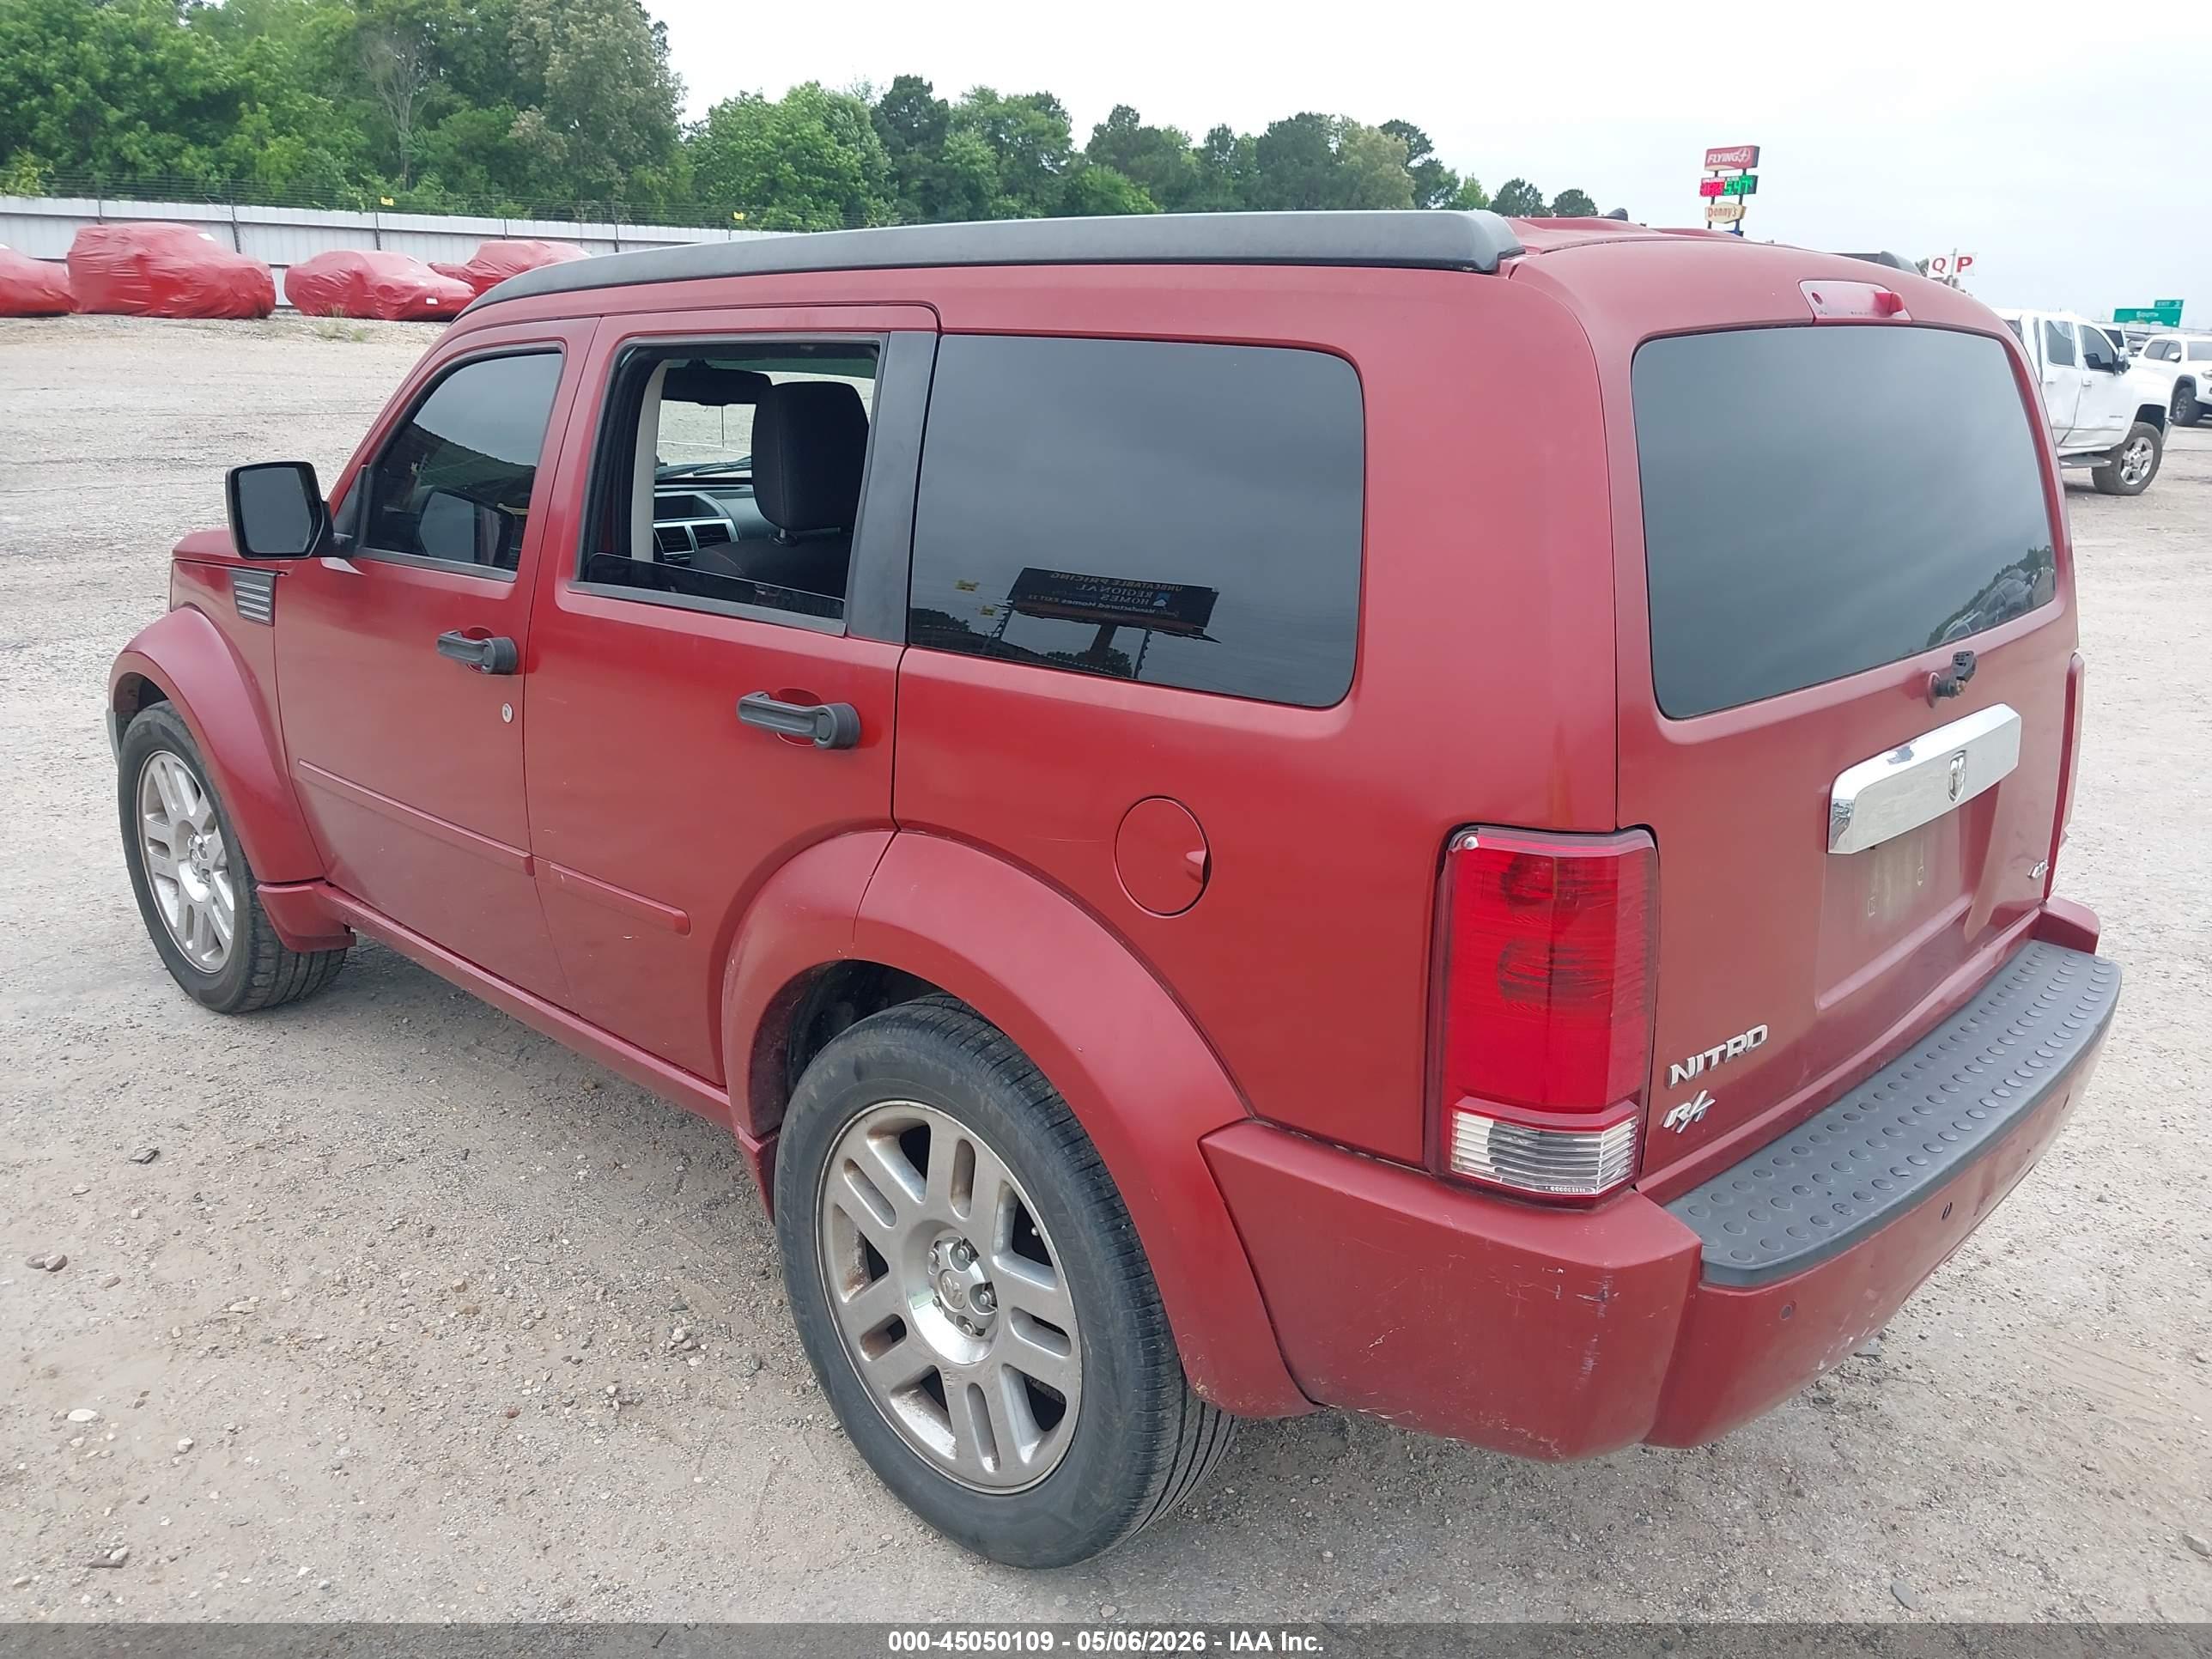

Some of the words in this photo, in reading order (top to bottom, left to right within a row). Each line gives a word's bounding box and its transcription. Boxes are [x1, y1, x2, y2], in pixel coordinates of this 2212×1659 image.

[1707, 152, 1739, 164] FLYING
[1708, 206, 1737, 217] Denny's
[1932, 257, 1947, 274] Q
[1956, 257, 1973, 273] P
[1668, 1024, 1769, 1089] NITRO
[1662, 1090, 1717, 1133] R/T
